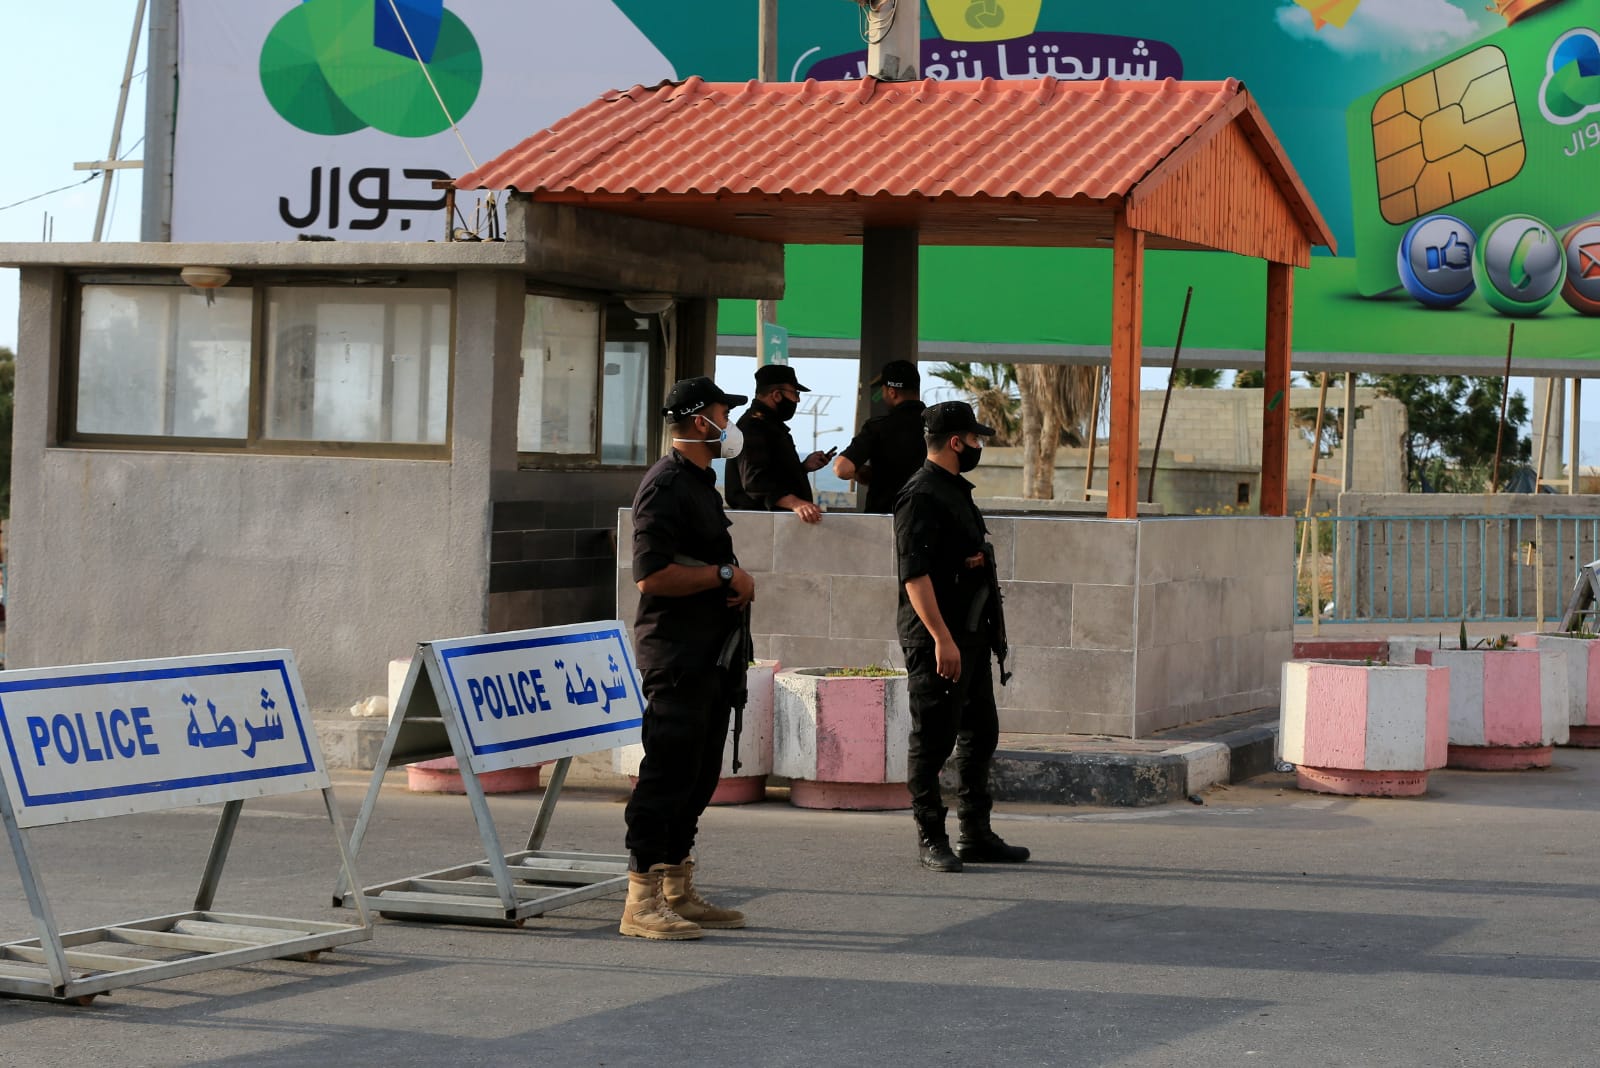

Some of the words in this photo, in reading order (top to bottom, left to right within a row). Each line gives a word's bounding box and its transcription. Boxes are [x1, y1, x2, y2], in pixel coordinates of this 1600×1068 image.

[1564, 122, 1600, 157] وال
[279, 166, 450, 231] جوال
[887, 380, 904, 388] POLICE
[467, 669, 552, 722] POLICE
[554, 653, 627, 714] شرطة
[26, 707, 160, 766] POLICE
[181, 688, 284, 759] شرطة
